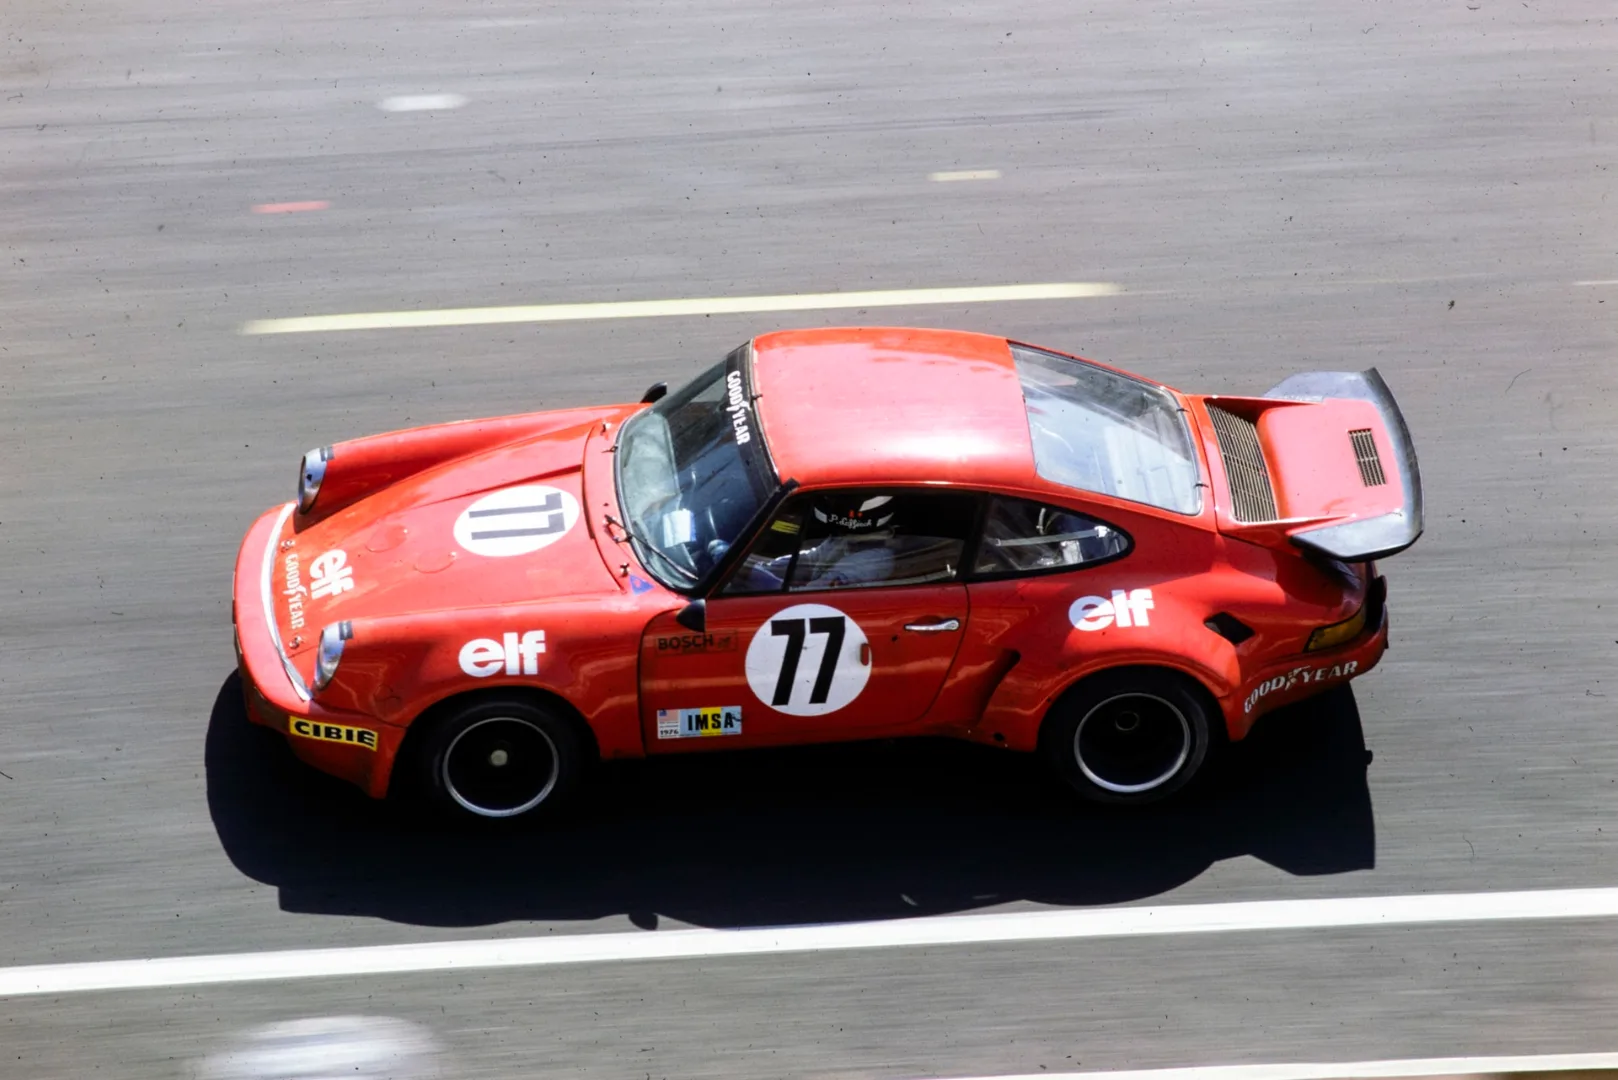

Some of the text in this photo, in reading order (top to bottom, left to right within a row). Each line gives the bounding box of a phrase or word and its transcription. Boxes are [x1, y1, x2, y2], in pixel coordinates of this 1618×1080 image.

[727, 370, 751, 445] GOODYEAR
[468, 492, 566, 541] 77
[284, 553, 307, 630] GOODYEAR
[309, 549, 355, 600] elf
[1068, 588, 1155, 632] elf
[458, 629, 546, 678] elf
[658, 634, 714, 650] BOSCH
[771, 616, 846, 706] 77
[688, 712, 734, 731] IMSA
